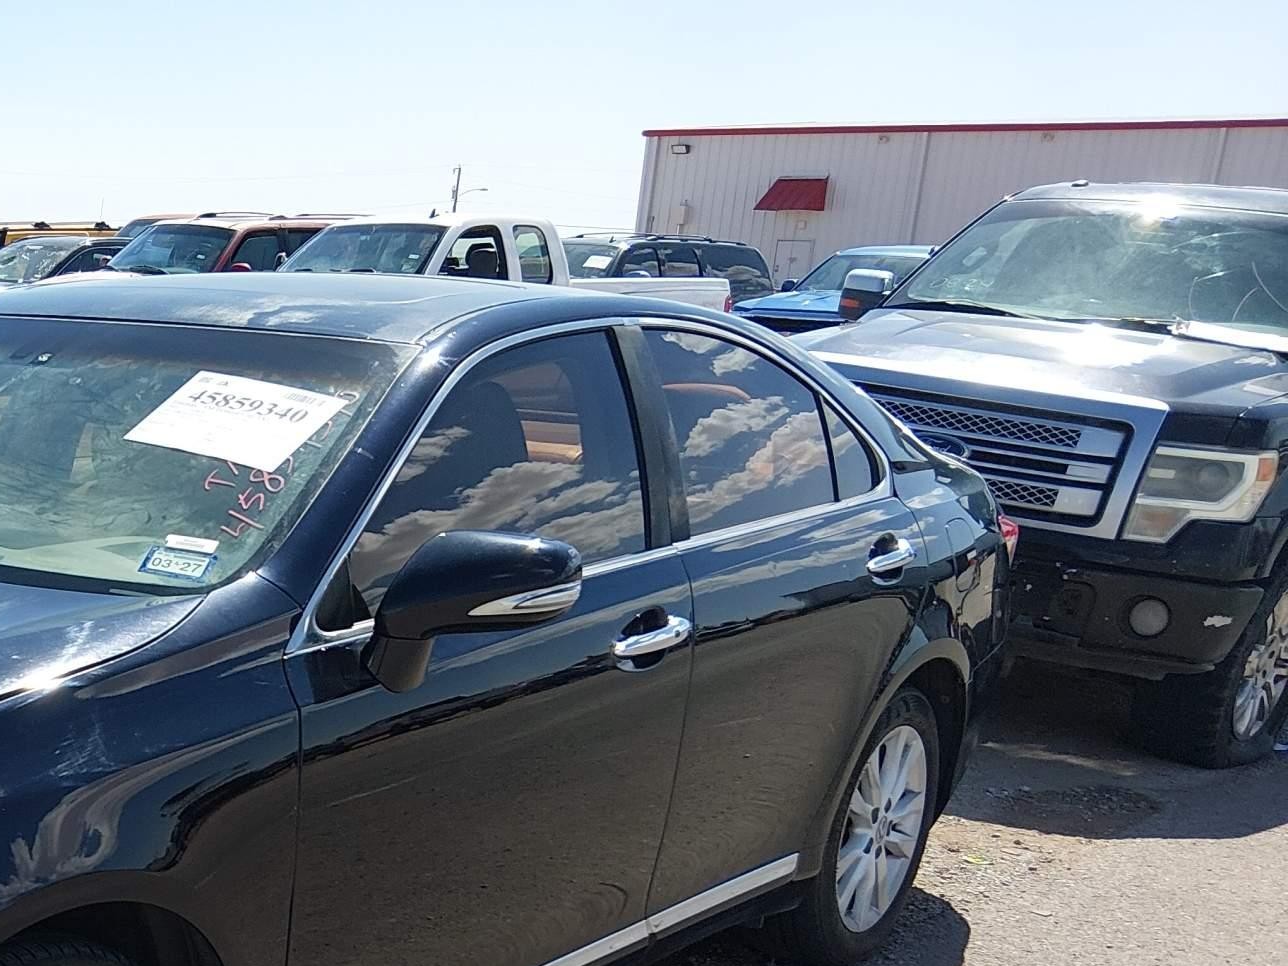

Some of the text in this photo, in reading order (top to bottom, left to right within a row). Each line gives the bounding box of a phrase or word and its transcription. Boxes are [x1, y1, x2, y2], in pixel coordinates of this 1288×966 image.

[188, 390, 309, 423] 45859340
[152, 557, 173, 569] 03
[179, 561, 202, 574] 27
